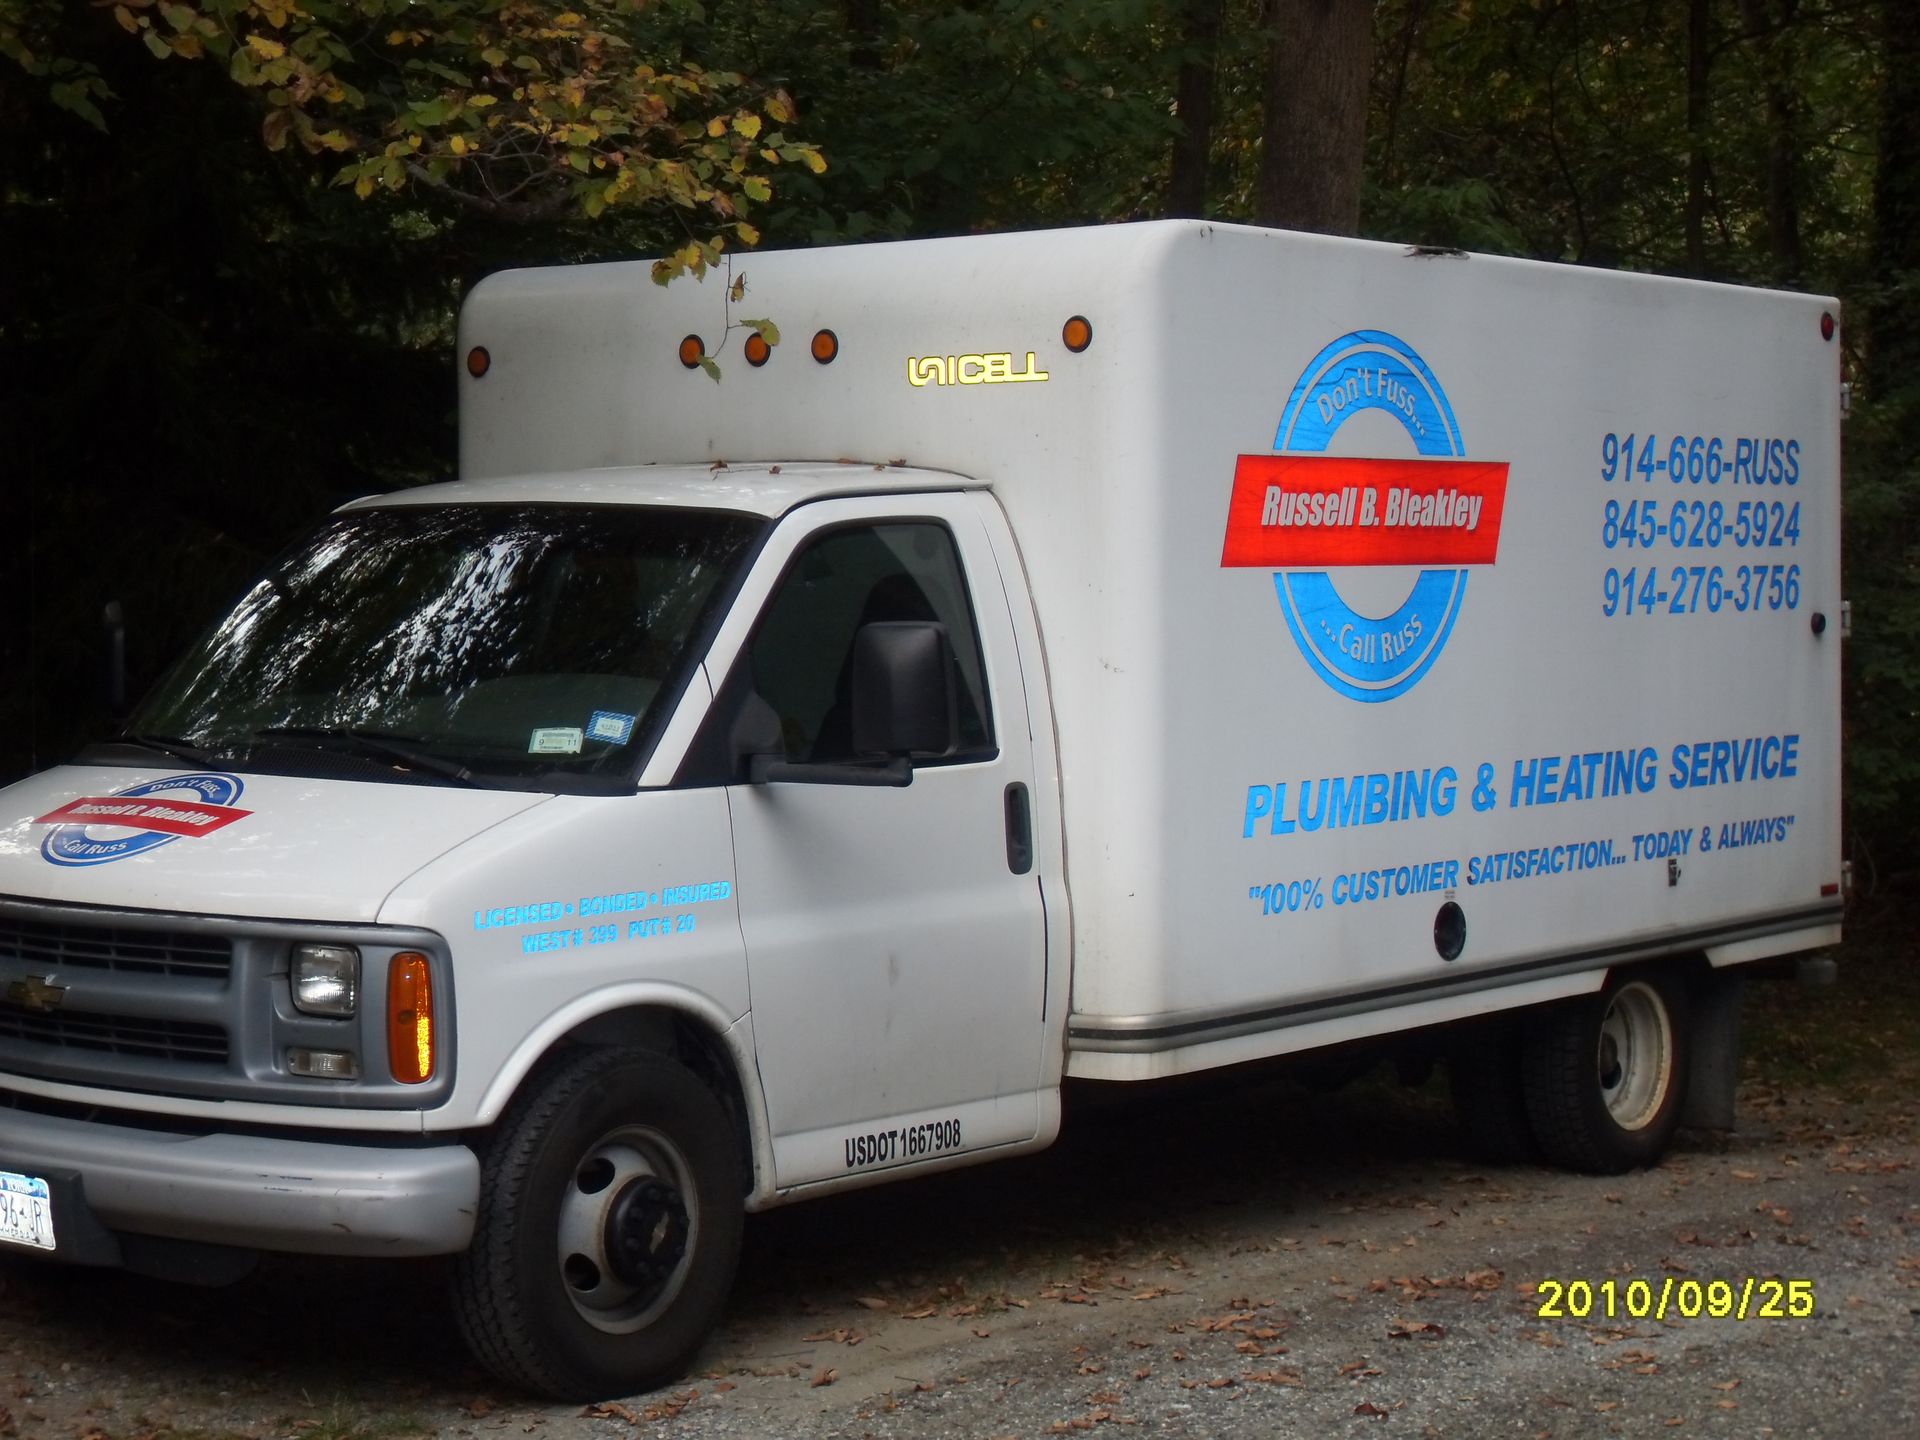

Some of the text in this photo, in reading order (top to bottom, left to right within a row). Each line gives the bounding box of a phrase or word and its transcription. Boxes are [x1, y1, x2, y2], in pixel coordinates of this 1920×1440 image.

[908, 352, 1049, 387] UNICELL
[1317, 367, 1425, 436] Don't Fuss...
[1601, 433, 1800, 485] 914-666-RUSS
[1261, 485, 1483, 531] Russell B. Bleakley
[1602, 500, 1800, 548] 845-628-5924
[1602, 564, 1800, 617] 914-276-3756
[1321, 613, 1422, 664] ...Call Russ
[1243, 734, 1799, 838] PLUMBING & HEATING SERVICE
[67, 803, 132, 815] Russell
[139, 806, 220, 826] Bleakley
[84, 842, 128, 855] Russ
[1249, 815, 1795, 916] "100% CUSTOMER SATISFACTION... TODAY & ALWAYS"
[474, 880, 731, 930] LICENSED BONDED INSURED
[589, 924, 618, 945] 399
[676, 913, 695, 934] 20
